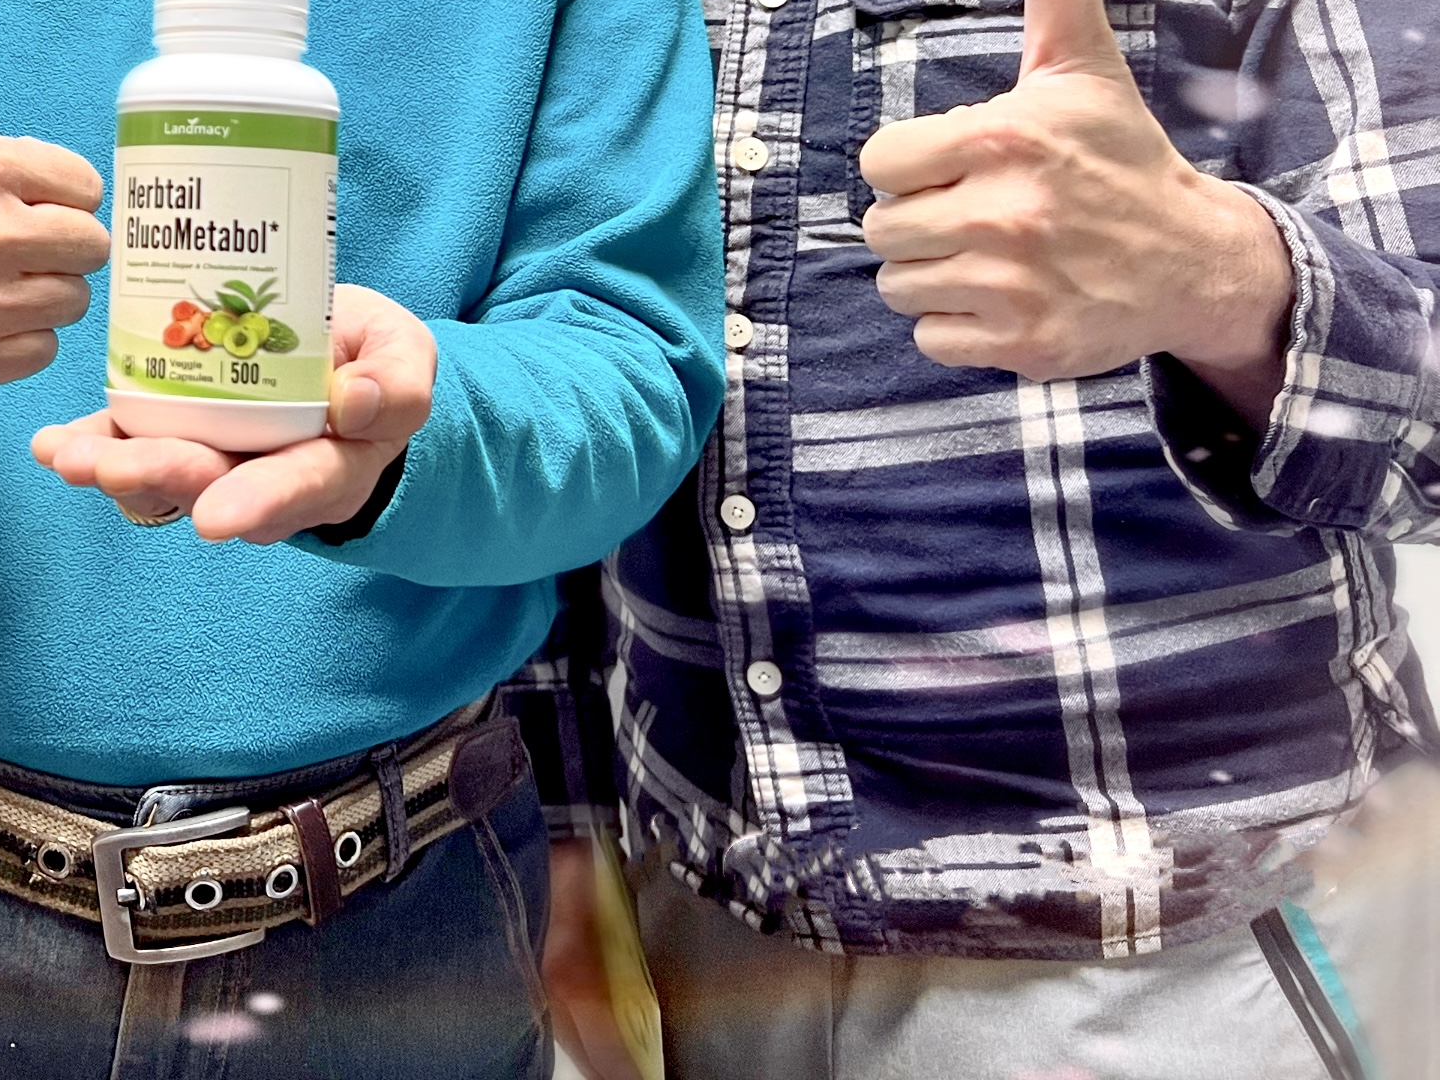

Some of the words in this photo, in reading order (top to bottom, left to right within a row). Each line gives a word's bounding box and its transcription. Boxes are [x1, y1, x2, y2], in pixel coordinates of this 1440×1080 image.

[164, 120, 230, 139] Landmacy
[128, 176, 202, 210] Herbtail
[145, 356, 166, 379] 180
[170, 359, 202, 370] Veggie
[169, 371, 214, 383] Capsules
[231, 362, 260, 385] 500
[262, 378, 277, 387] mg
